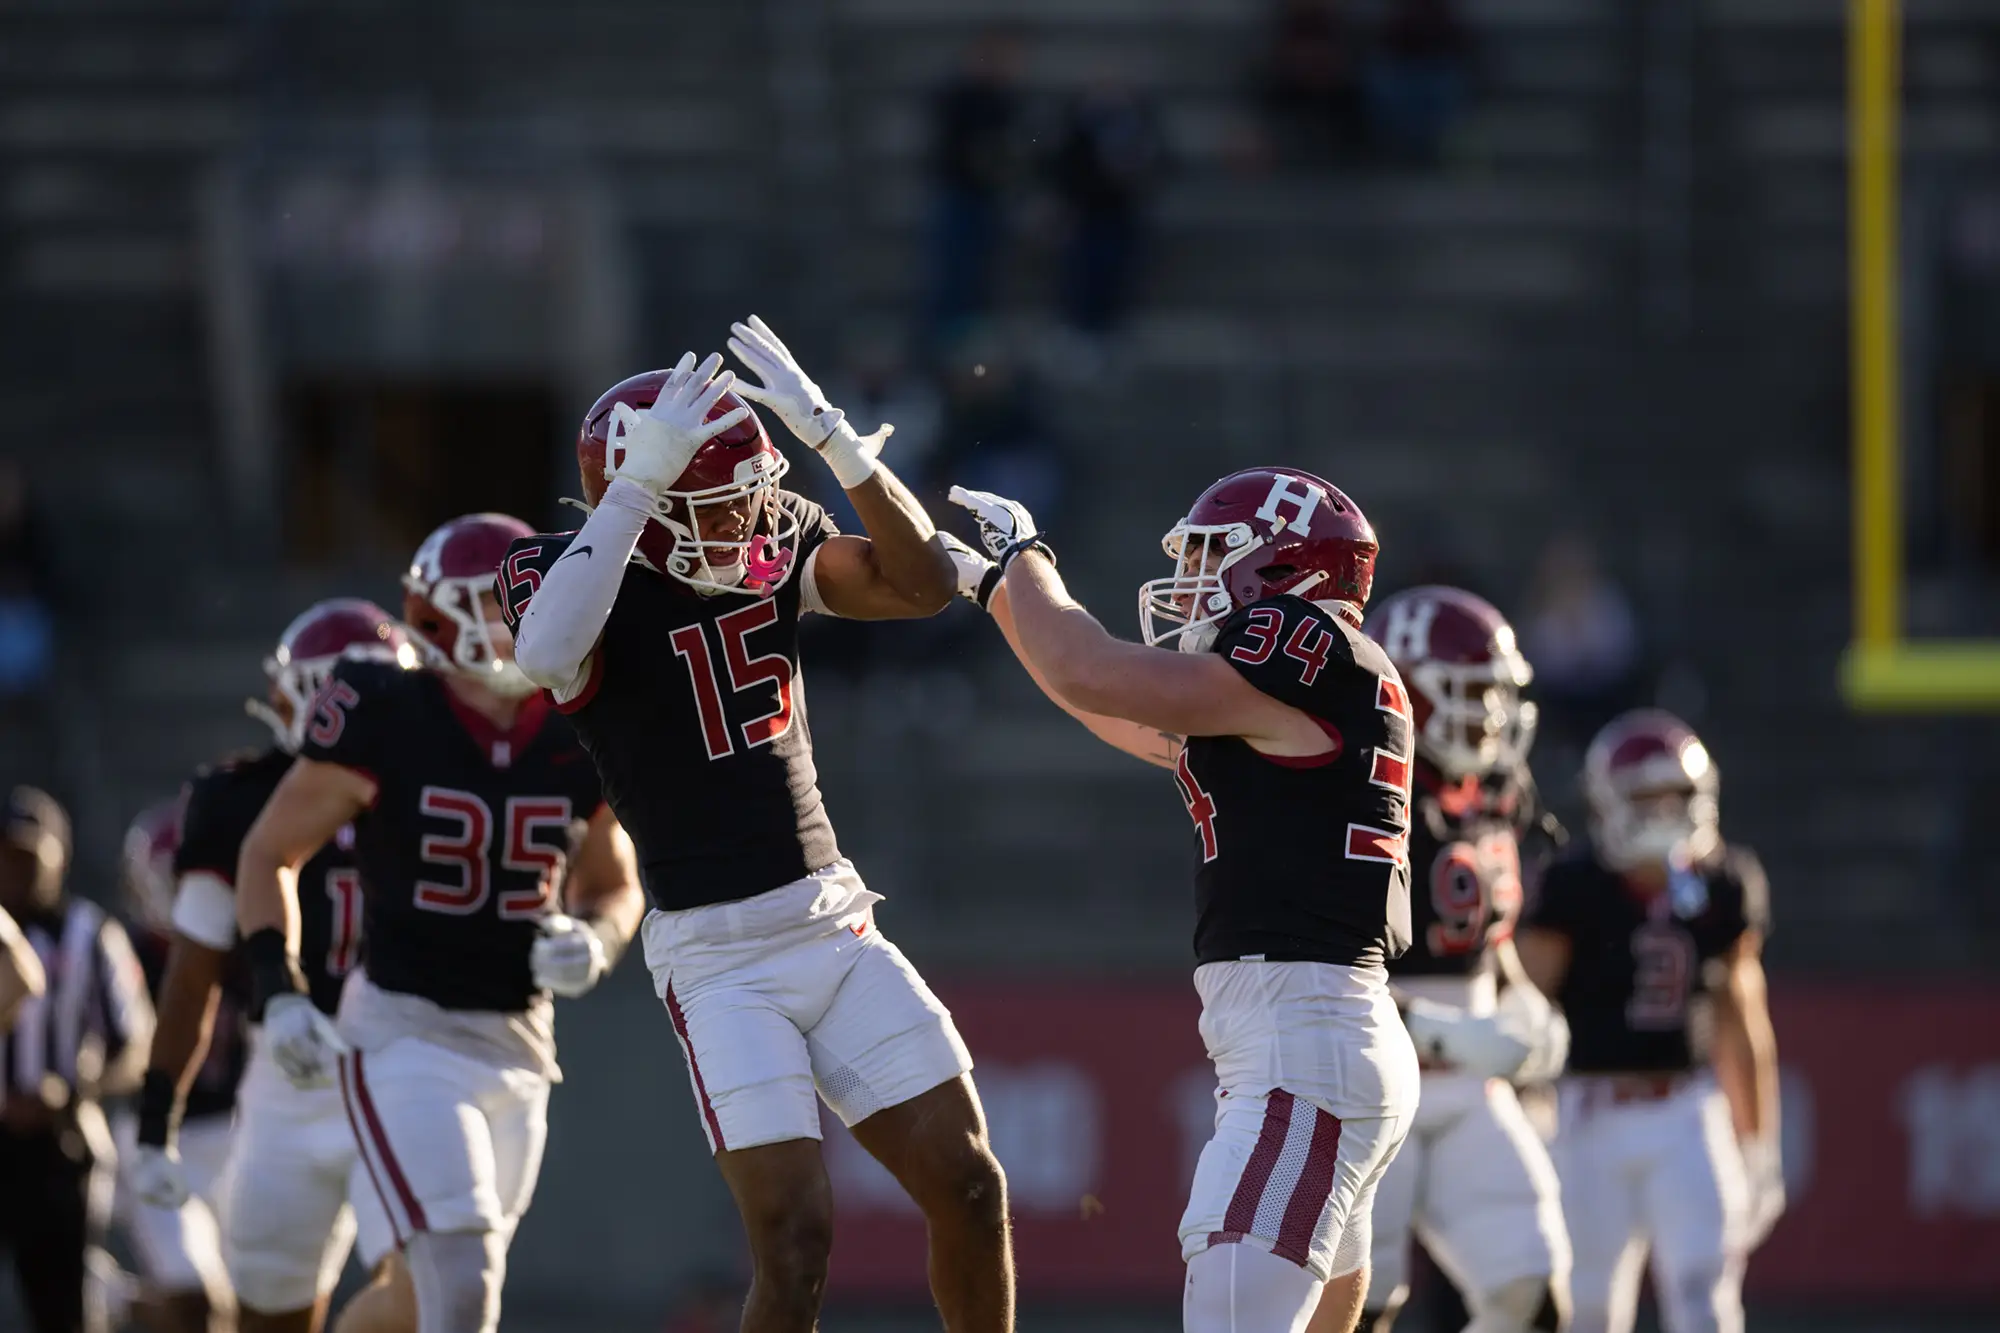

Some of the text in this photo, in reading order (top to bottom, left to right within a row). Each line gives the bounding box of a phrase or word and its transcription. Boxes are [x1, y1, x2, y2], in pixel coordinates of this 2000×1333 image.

[1256, 474, 1327, 538] H
[668, 595, 794, 761] 15
[1231, 607, 1333, 687] 34
[412, 785, 572, 921] 35
[325, 867, 364, 978] 1
